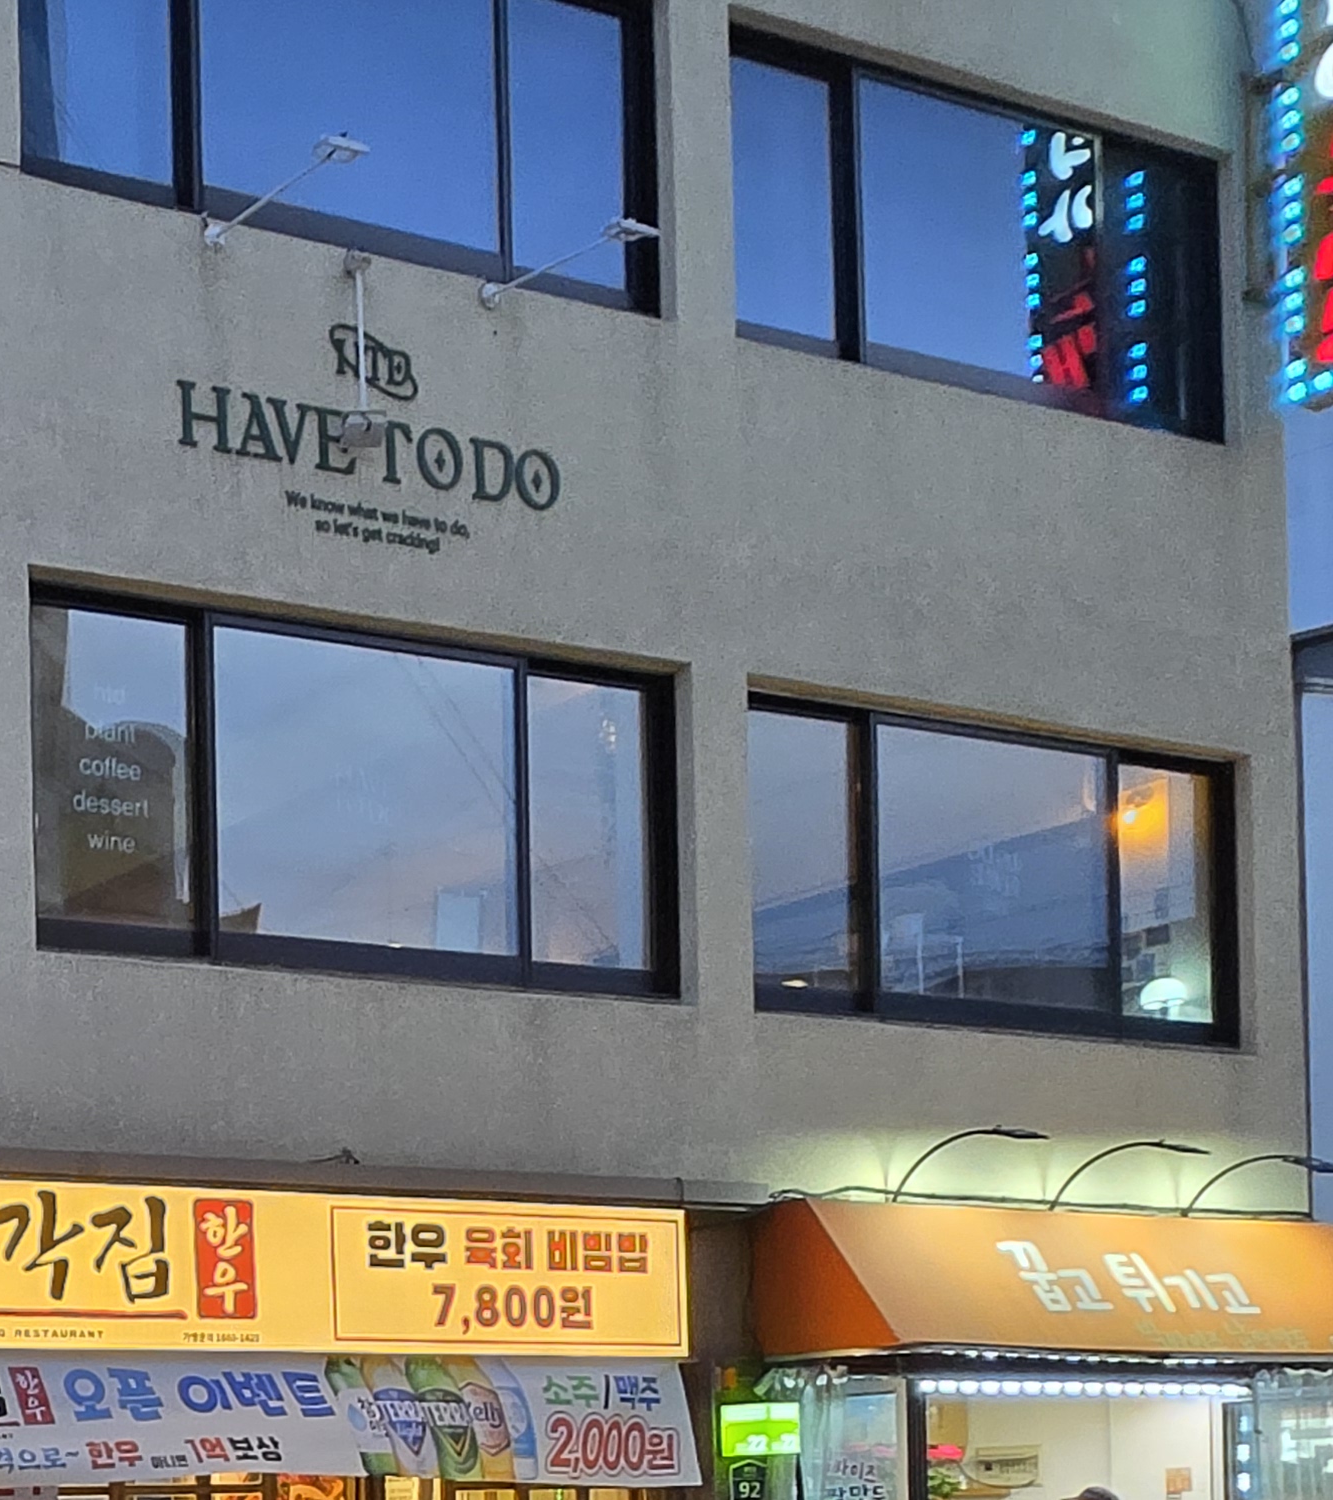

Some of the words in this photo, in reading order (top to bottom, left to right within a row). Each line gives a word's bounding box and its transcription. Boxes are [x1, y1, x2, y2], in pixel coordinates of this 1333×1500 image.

[285, 489, 307, 509] We
[310, 494, 345, 515] know
[347, 502, 379, 521] what
[380, 510, 399, 524] we
[402, 509, 431, 531] have
[434, 517, 448, 533] to
[315, 519, 331, 533] so
[362, 527, 383, 544] get
[84, 722, 136, 745] plant
[79, 756, 142, 781] coffee
[72, 789, 149, 819] dessert
[87, 830, 136, 854] wine
[199, 1204, 249, 1315] 한우
[366, 1219, 449, 1271] 한우
[463, 1225, 535, 1271] 육회
[546, 1229, 650, 1275] 비빔밥
[1102, 1251, 1262, 1315] 튀기고
[430, 1282, 595, 1335] 7,800원
[13, 1328, 105, 1340] RESTAURANT
[62, 1367, 165, 1423] 오픈
[176, 1369, 337, 1419] 이벤트
[85, 1439, 144, 1471] 한우
[184, 1437, 231, 1466] 1억
[227, 1435, 284, 1465] 보상
[543, 1410, 680, 1477] 2,000원
[738, 1480, 762, 1499] 92
